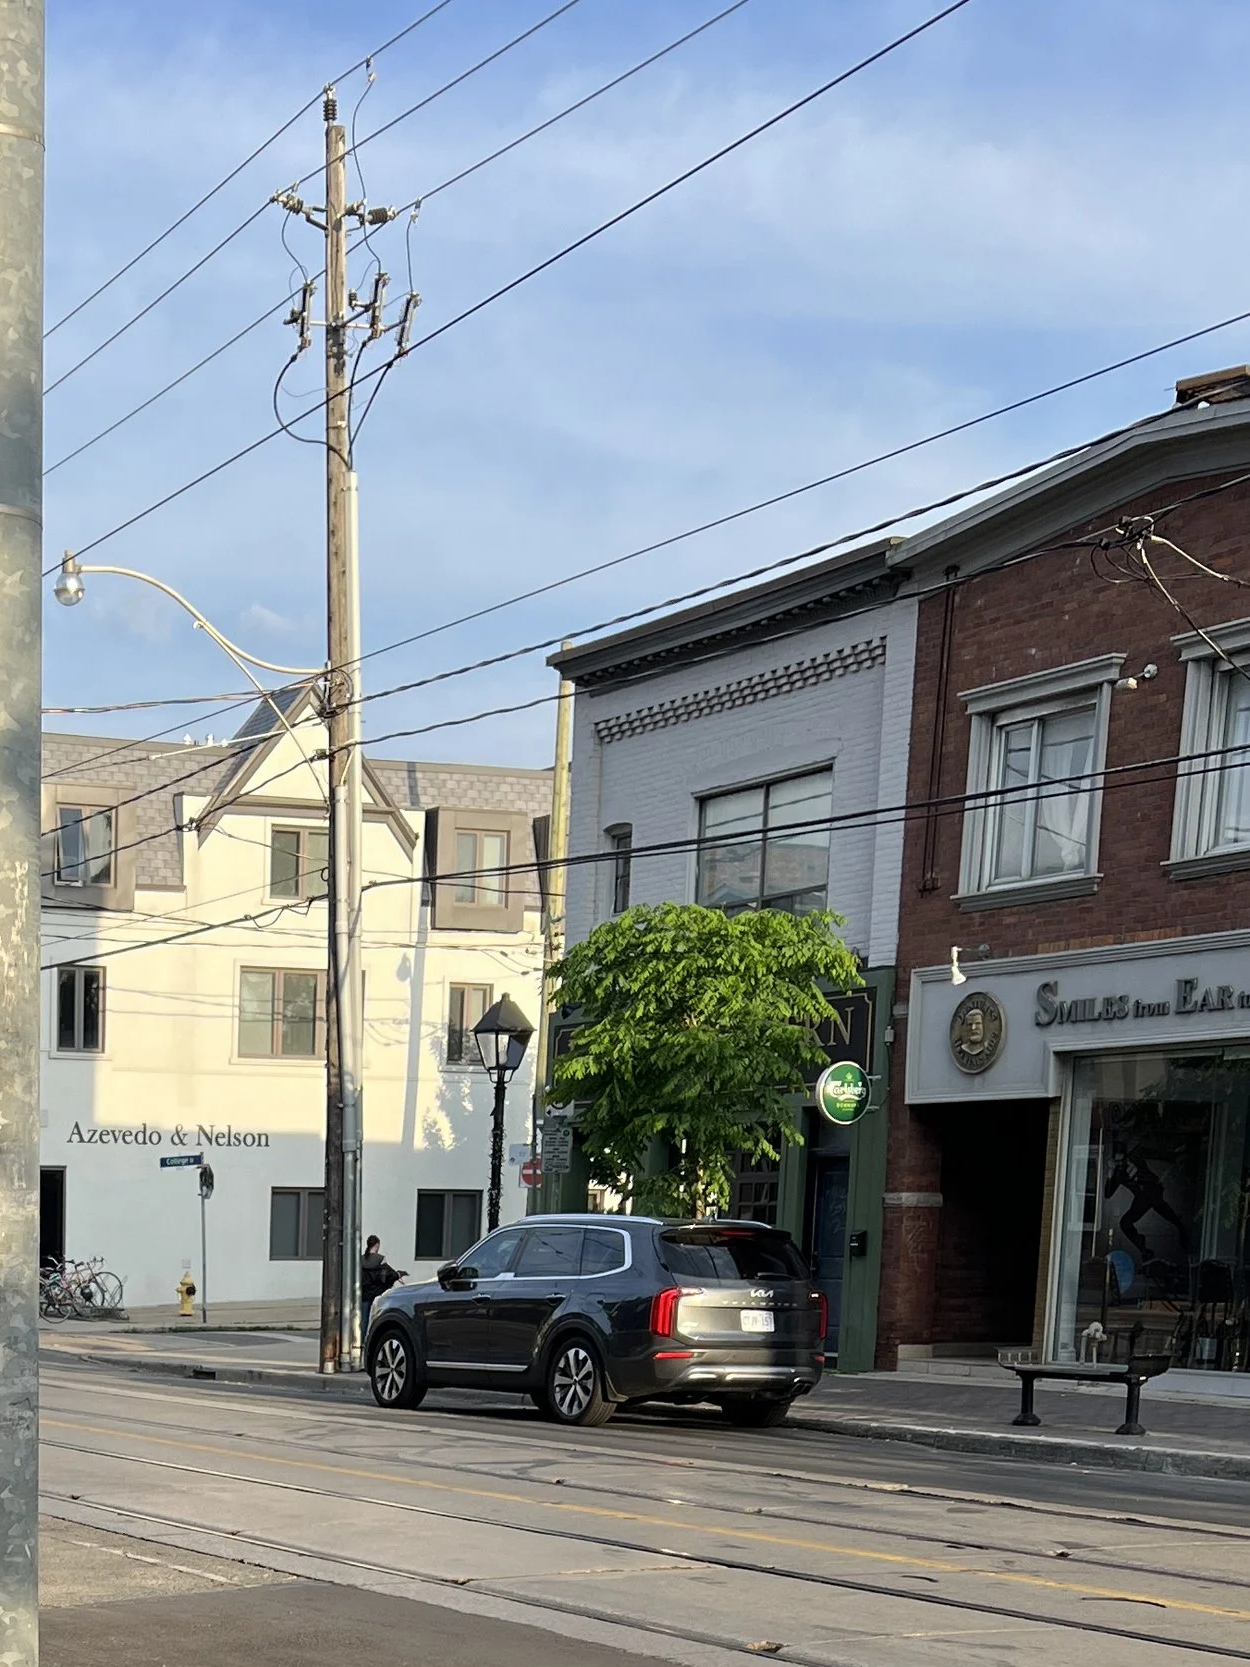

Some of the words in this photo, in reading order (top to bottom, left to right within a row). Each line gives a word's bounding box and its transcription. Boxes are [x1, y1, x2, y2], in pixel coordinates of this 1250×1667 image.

[1035, 981, 1130, 1026] SMILES
[1134, 999, 1170, 1018] from
[1175, 977, 1235, 1015] EAR
[67, 1121, 162, 1146] Azevedo
[170, 1124, 189, 1146] &
[196, 1124, 270, 1147] Nelson
